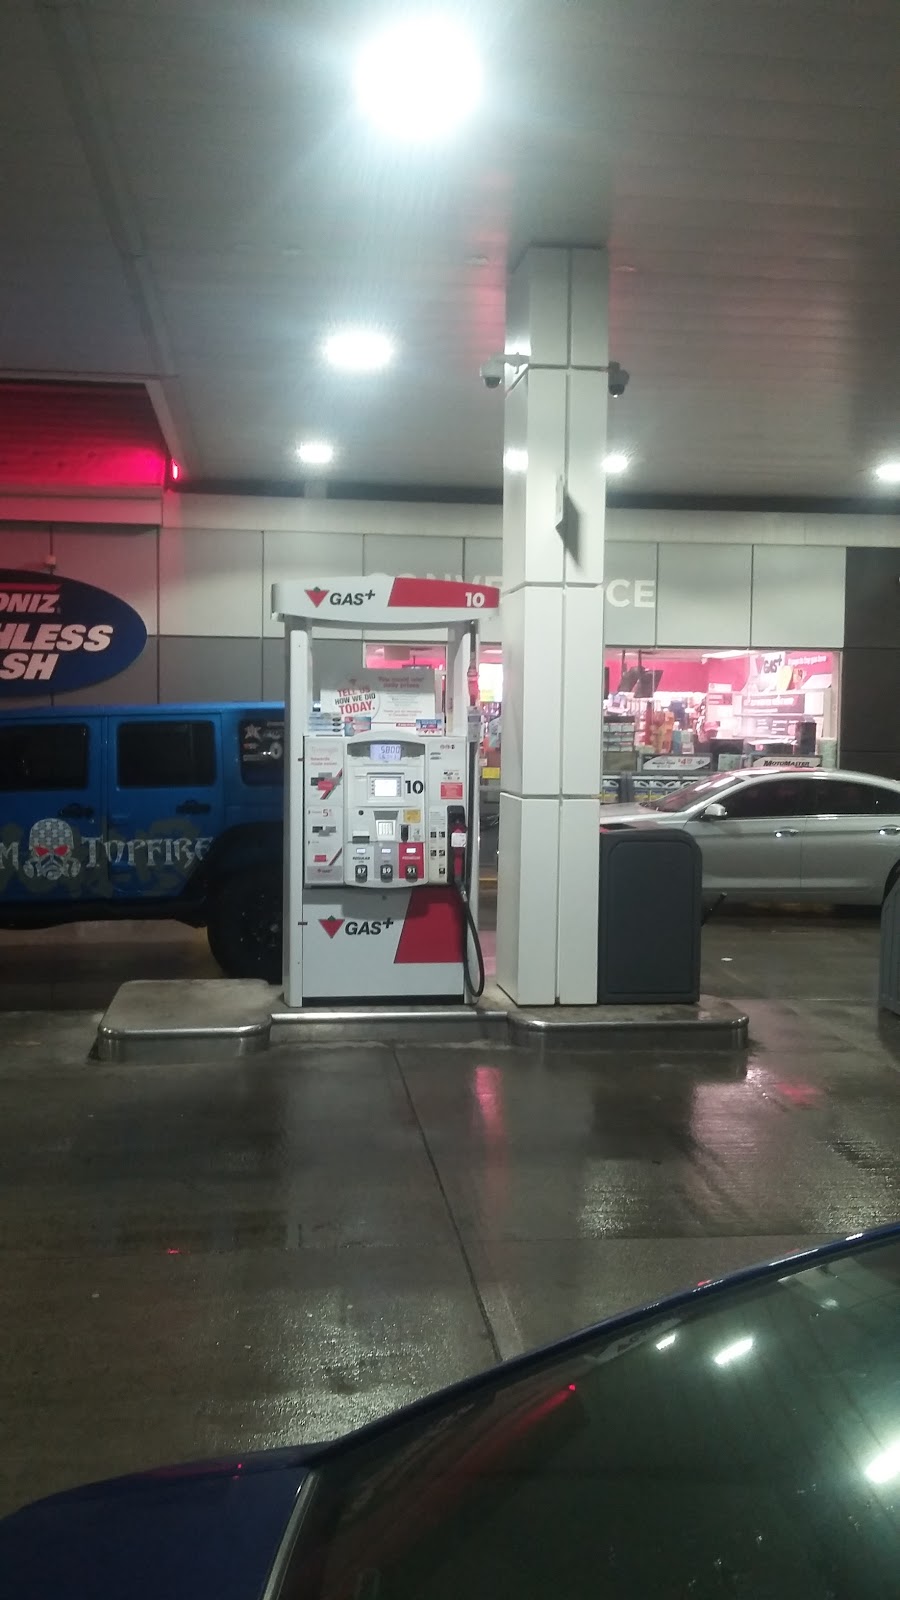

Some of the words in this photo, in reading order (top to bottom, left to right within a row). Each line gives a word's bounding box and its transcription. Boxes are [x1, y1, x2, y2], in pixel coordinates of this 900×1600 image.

[329, 590, 375, 606] GAS+
[465, 592, 485, 608] 10
[0, 652, 59, 680] SH
[338, 689, 358, 698] TELL
[360, 686, 371, 695] US
[335, 697, 350, 705] HOW
[340, 701, 376, 715] TODAY.
[405, 780, 424, 795] 10
[345, 917, 394, 935] GAS+
